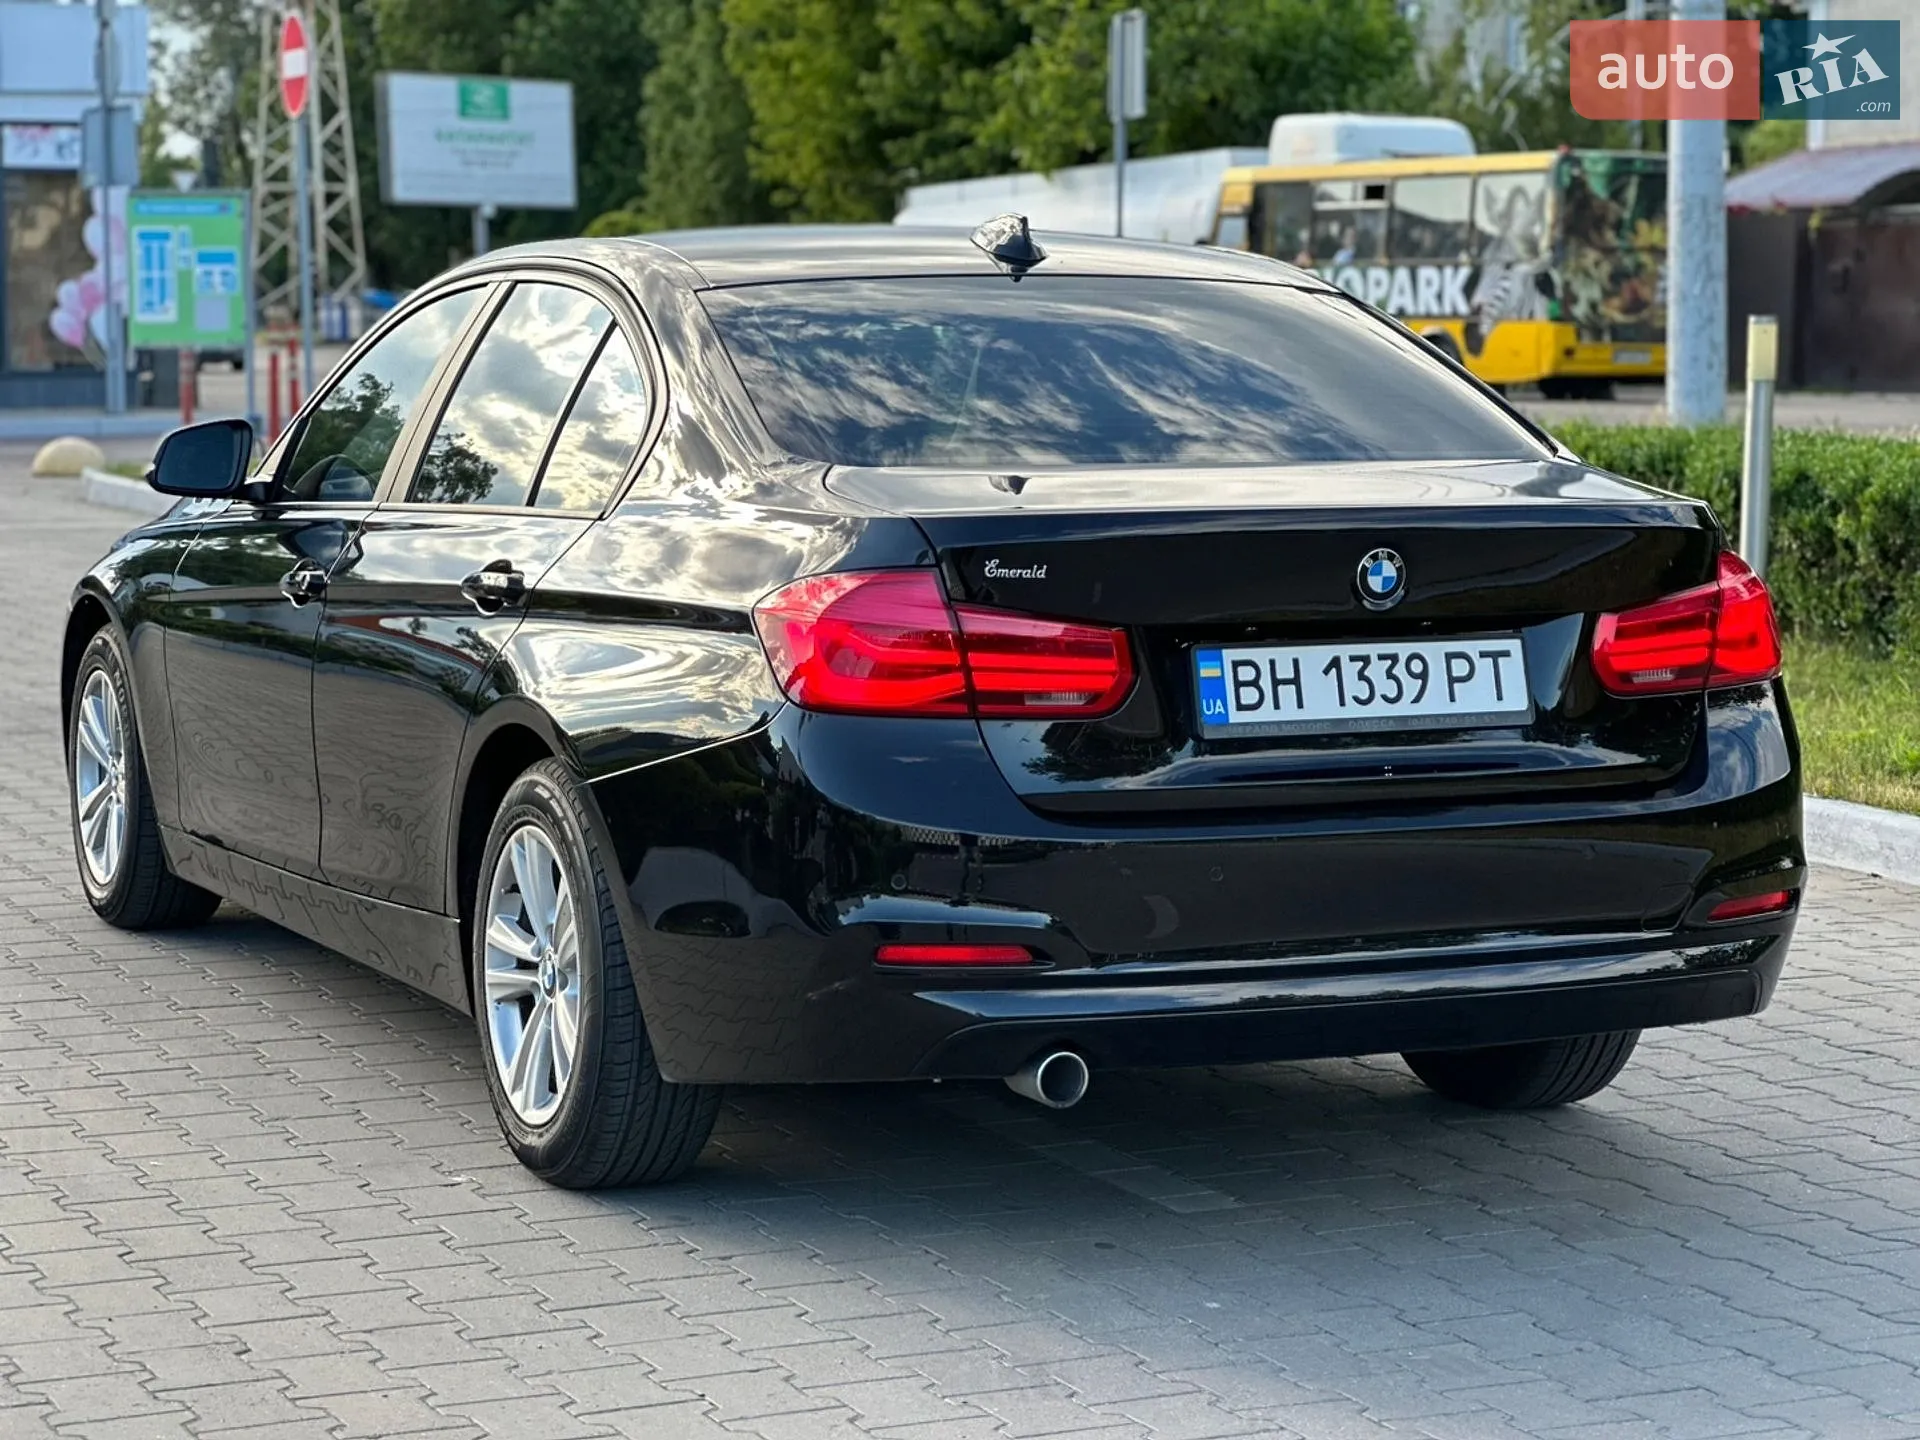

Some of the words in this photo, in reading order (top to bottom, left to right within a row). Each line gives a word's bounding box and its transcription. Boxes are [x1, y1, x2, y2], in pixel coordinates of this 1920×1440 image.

[1307, 266, 1472, 316] OPARK
[984, 558, 1048, 579] Emerald
[1231, 657, 1304, 712] BH
[1322, 652, 1430, 708] 1339
[1444, 649, 1512, 703] PT
[1202, 698, 1225, 715] UA
